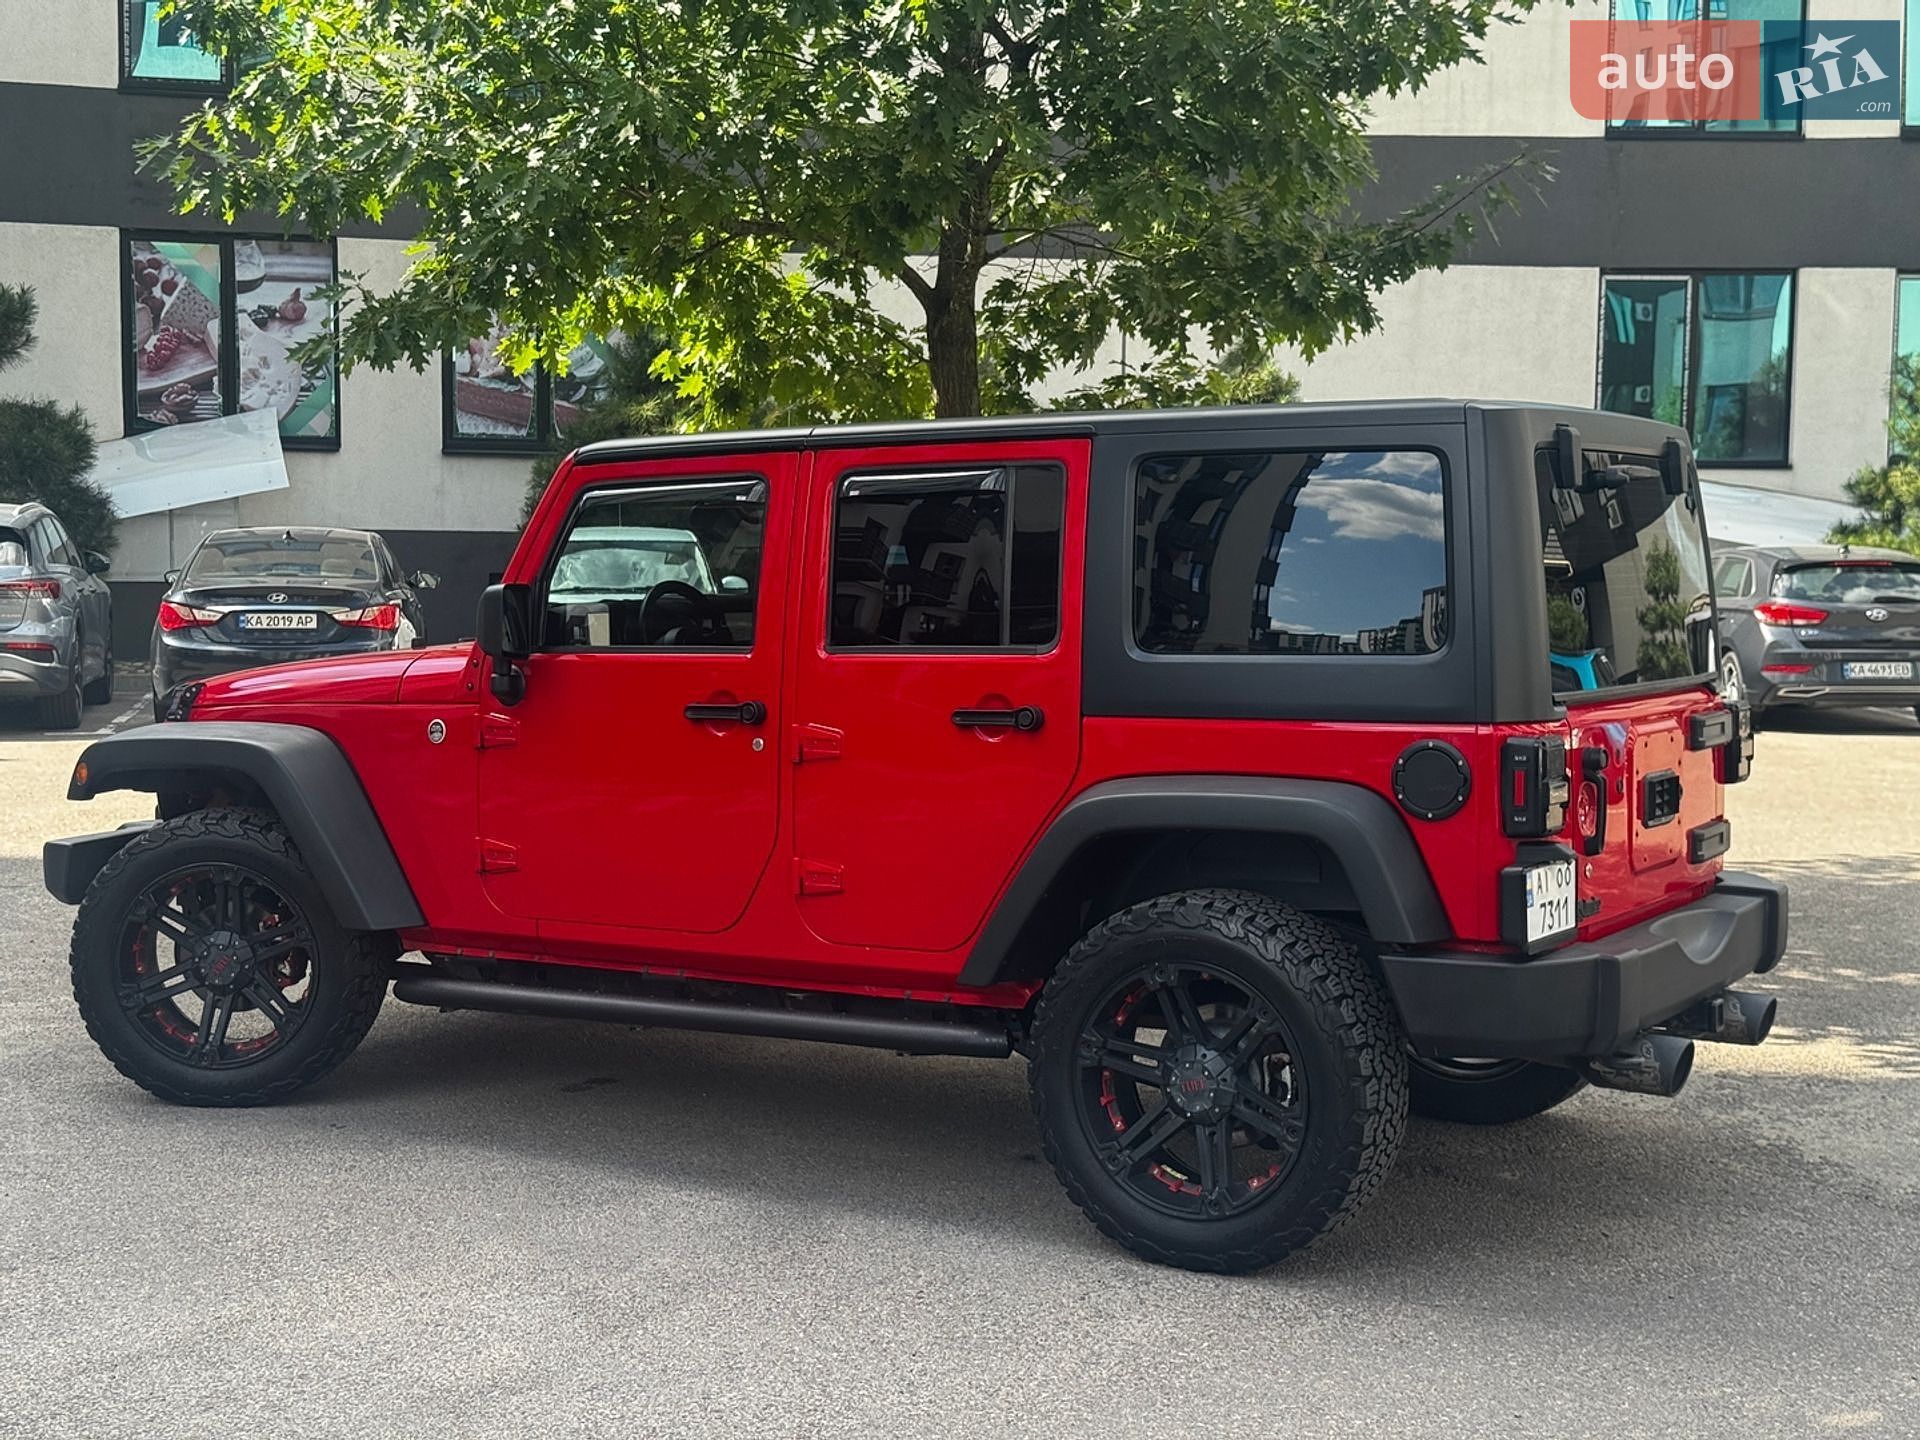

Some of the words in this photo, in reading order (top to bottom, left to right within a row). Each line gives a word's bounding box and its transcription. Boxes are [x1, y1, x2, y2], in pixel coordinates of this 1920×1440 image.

[246, 615, 263, 627] KA
[266, 615, 294, 627] 2019
[297, 615, 313, 627] AP
[1849, 664, 1865, 676] KA
[1537, 869, 1549, 895] AI
[1539, 896, 1569, 934] 7311
